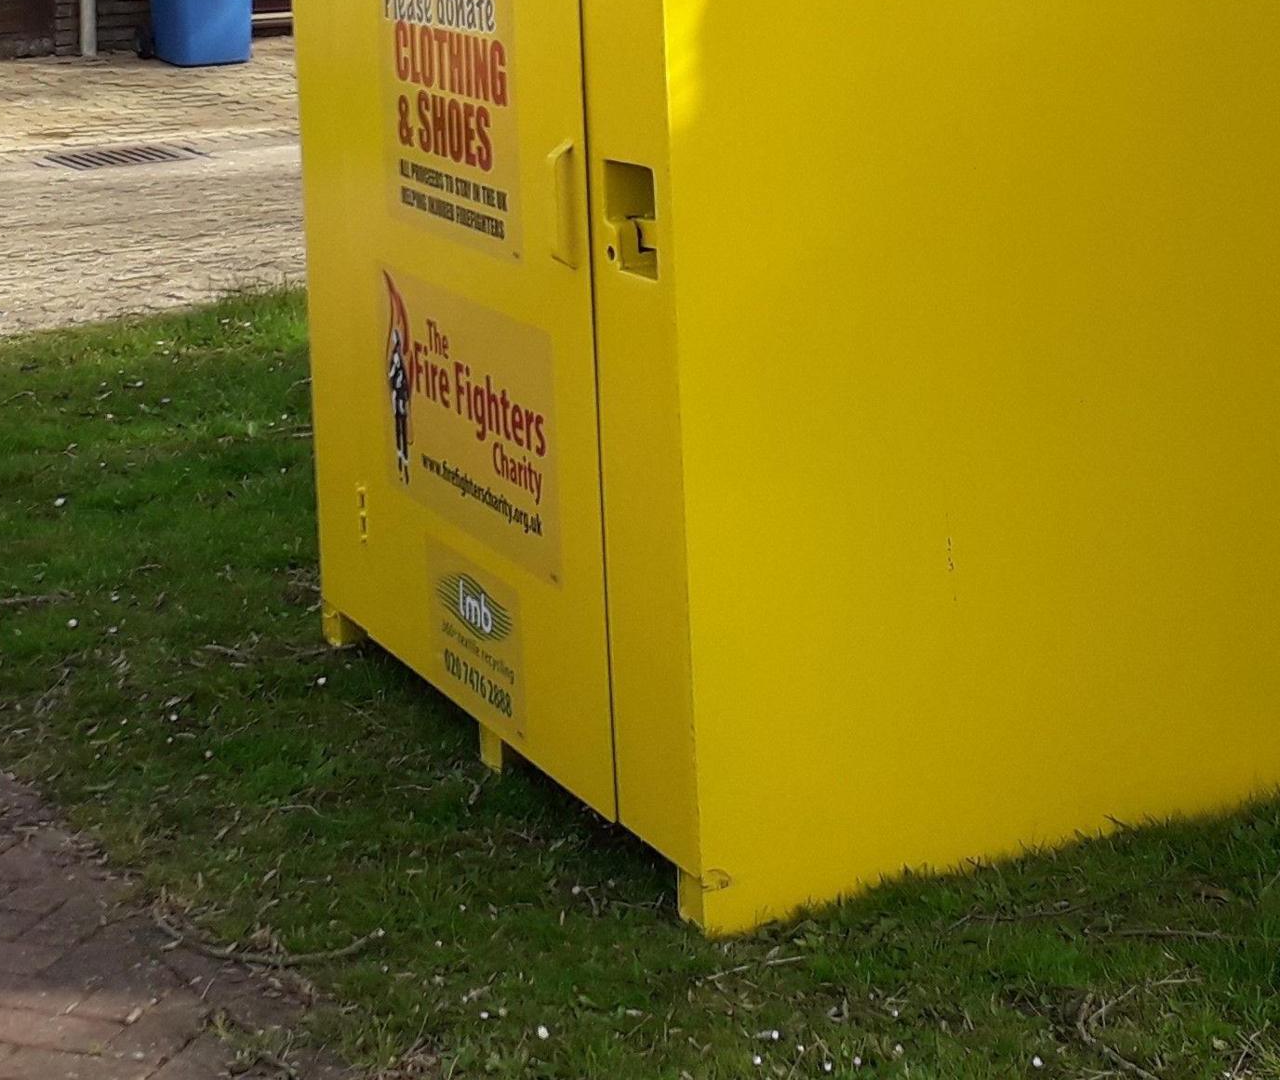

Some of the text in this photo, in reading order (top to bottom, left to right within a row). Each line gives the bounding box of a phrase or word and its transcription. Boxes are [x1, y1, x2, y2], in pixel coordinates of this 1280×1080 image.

[395, 20, 508, 107] CLOTHING
[398, 89, 493, 172] & SHOES
[481, 185, 496, 208] THE
[496, 190, 508, 212] UK
[425, 318, 449, 360] The
[414, 340, 547, 458] Fire Fighters
[421, 453, 543, 537] www.firefighterscharity.org.uk
[492, 441, 543, 505] Charity
[458, 578, 493, 634] lmb
[443, 648, 461, 681] 020
